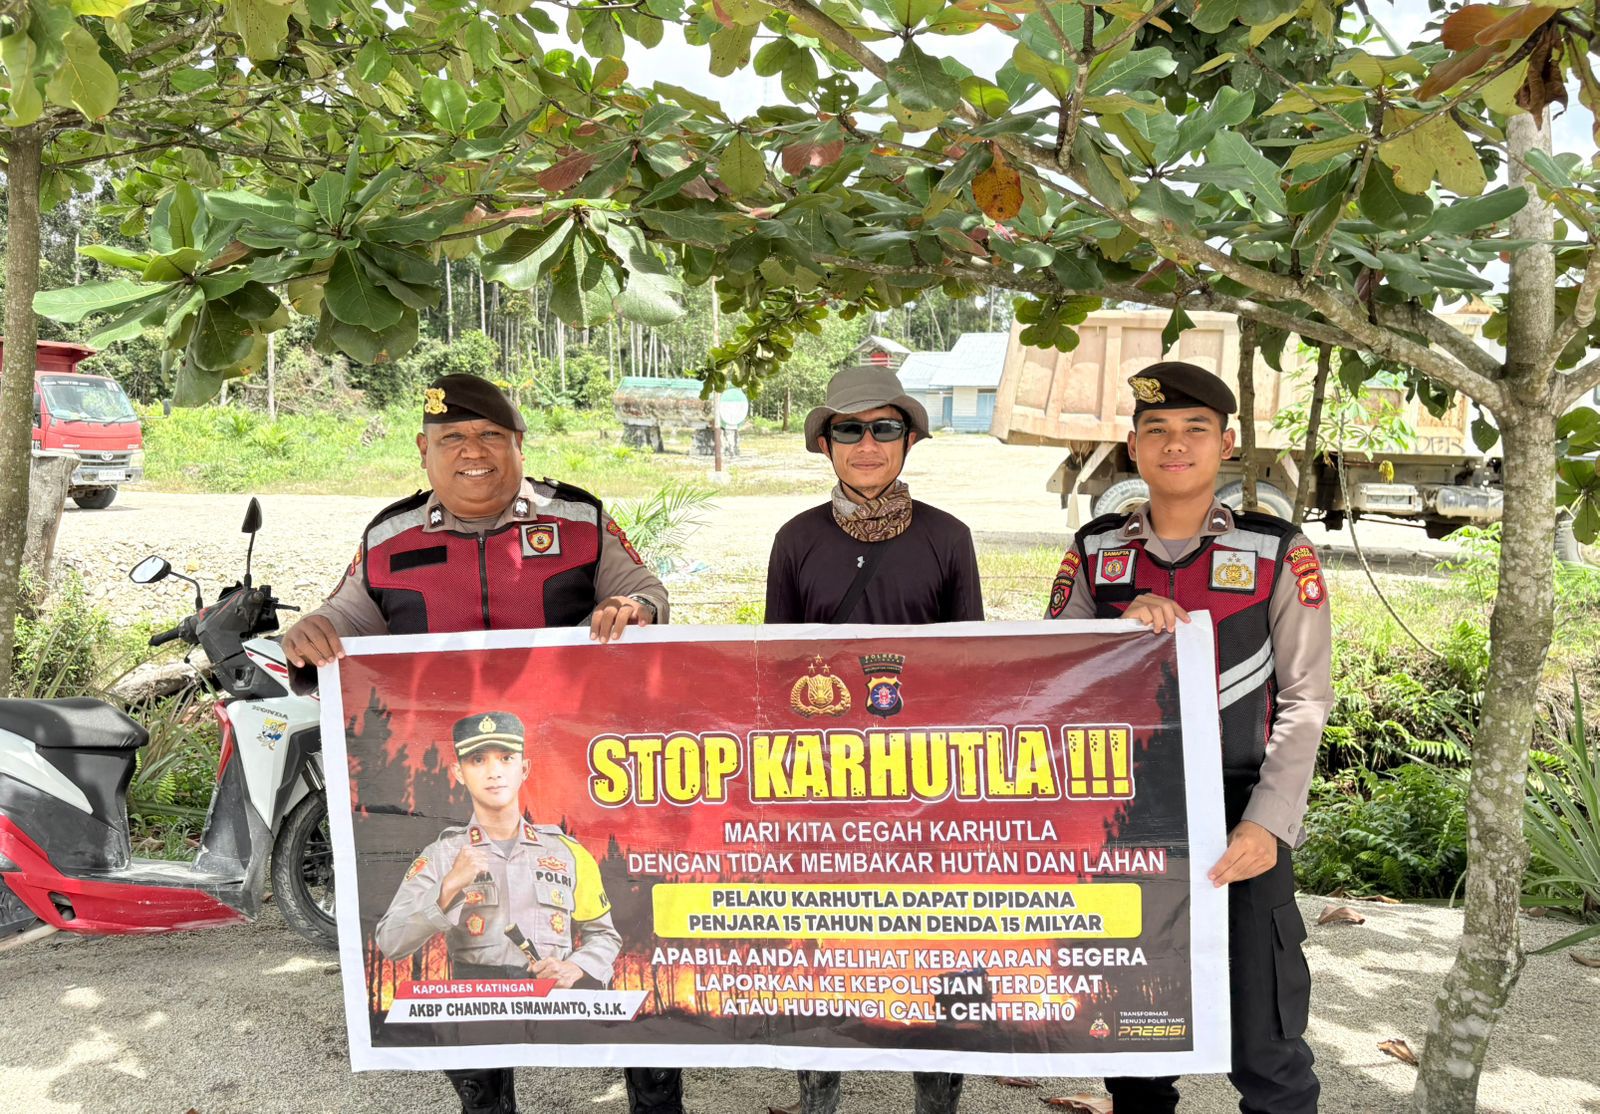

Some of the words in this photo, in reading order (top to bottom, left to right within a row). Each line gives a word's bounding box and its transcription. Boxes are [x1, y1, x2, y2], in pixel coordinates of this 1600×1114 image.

[864, 652, 900, 661] POLRES
[590, 734, 740, 805] STOP
[752, 728, 1056, 800] KARHUTLA
[1066, 728, 1130, 796] !!!
[724, 821, 780, 843] MARI
[787, 821, 837, 842] KITA
[842, 821, 922, 842] CEGAH
[930, 820, 1058, 842] KARHUTLA
[628, 853, 721, 873] DENGAN
[727, 853, 795, 873] TIDAK
[801, 852, 933, 873] MEMBAKAR
[941, 852, 1018, 873] HUTAN
[1026, 851, 1075, 873] DAN
[1083, 850, 1165, 872] LAHAN
[535, 871, 572, 888] POLRI
[712, 890, 786, 908] PELAKU
[791, 890, 898, 908] KARHUTLA
[903, 891, 969, 908] DAPAT
[973, 891, 1075, 908] DIPIDANA
[688, 914, 780, 932] PENJARA
[782, 915, 801, 931] 15
[805, 914, 874, 932] TAHUN
[878, 915, 922, 932] DAN
[927, 915, 998, 932] DENDA
[1000, 916, 1021, 932] 15
[1025, 914, 1103, 932] MILYAR
[651, 947, 742, 966] APABILA
[746, 948, 809, 968] ANDA
[813, 949, 910, 969] MELIHAT
[914, 949, 1052, 969] KEBAKARAN
[1058, 947, 1148, 967] SEGERA
[412, 982, 473, 995] KAPOLRES
[475, 982, 535, 994] KATINGAN
[695, 974, 814, 992] LAPORKAN
[819, 975, 846, 993] KE
[851, 975, 984, 995] KEPOLISIAN
[988, 974, 1103, 995] TERDEKAT
[408, 1002, 443, 1018] AKBP
[446, 1001, 508, 1017] CHANDRA
[511, 1001, 591, 1018] ISMAWANTO,
[593, 1002, 627, 1016] S.I.K.
[722, 998, 778, 1016] ATAU
[784, 999, 885, 1018] HUBUNGI
[890, 1001, 947, 1020] CALL
[951, 1002, 1041, 1021] CENTER
[1043, 1002, 1076, 1021] 110
[1118, 1025, 1187, 1037] PRESISI
